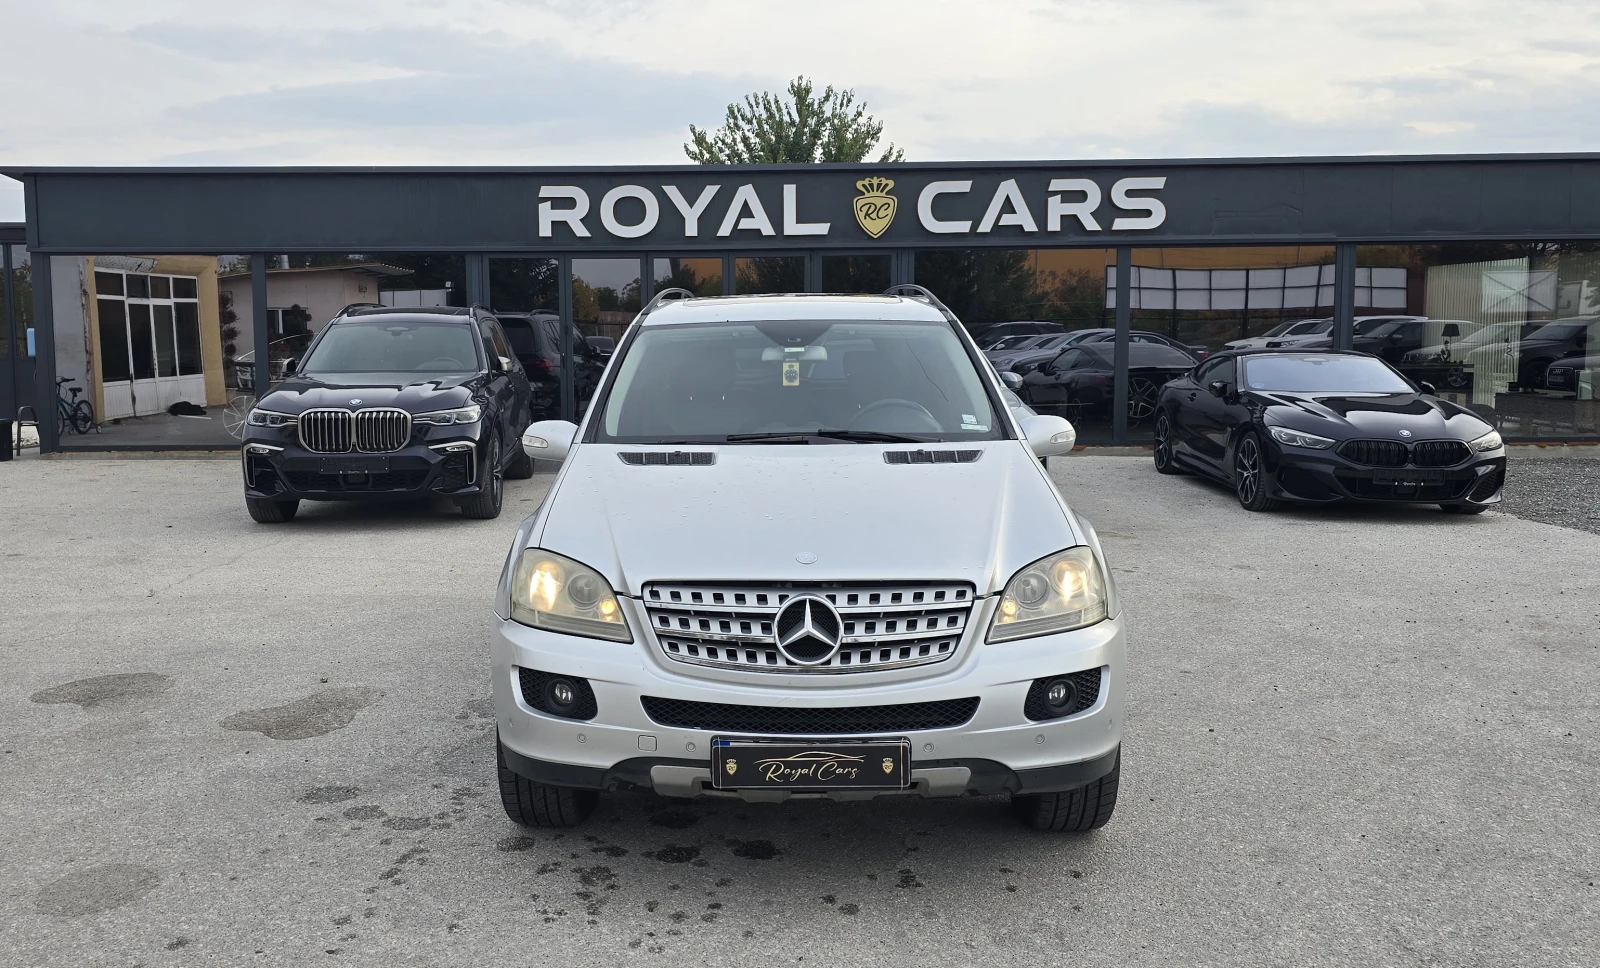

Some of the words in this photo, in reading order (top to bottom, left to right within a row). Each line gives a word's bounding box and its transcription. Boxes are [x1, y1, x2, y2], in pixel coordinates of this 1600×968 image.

[538, 183, 831, 238] ROYAL
[917, 176, 1167, 234] CARS
[859, 202, 891, 221] RC
[758, 761, 816, 782] Royal
[817, 761, 861, 780] Cars
